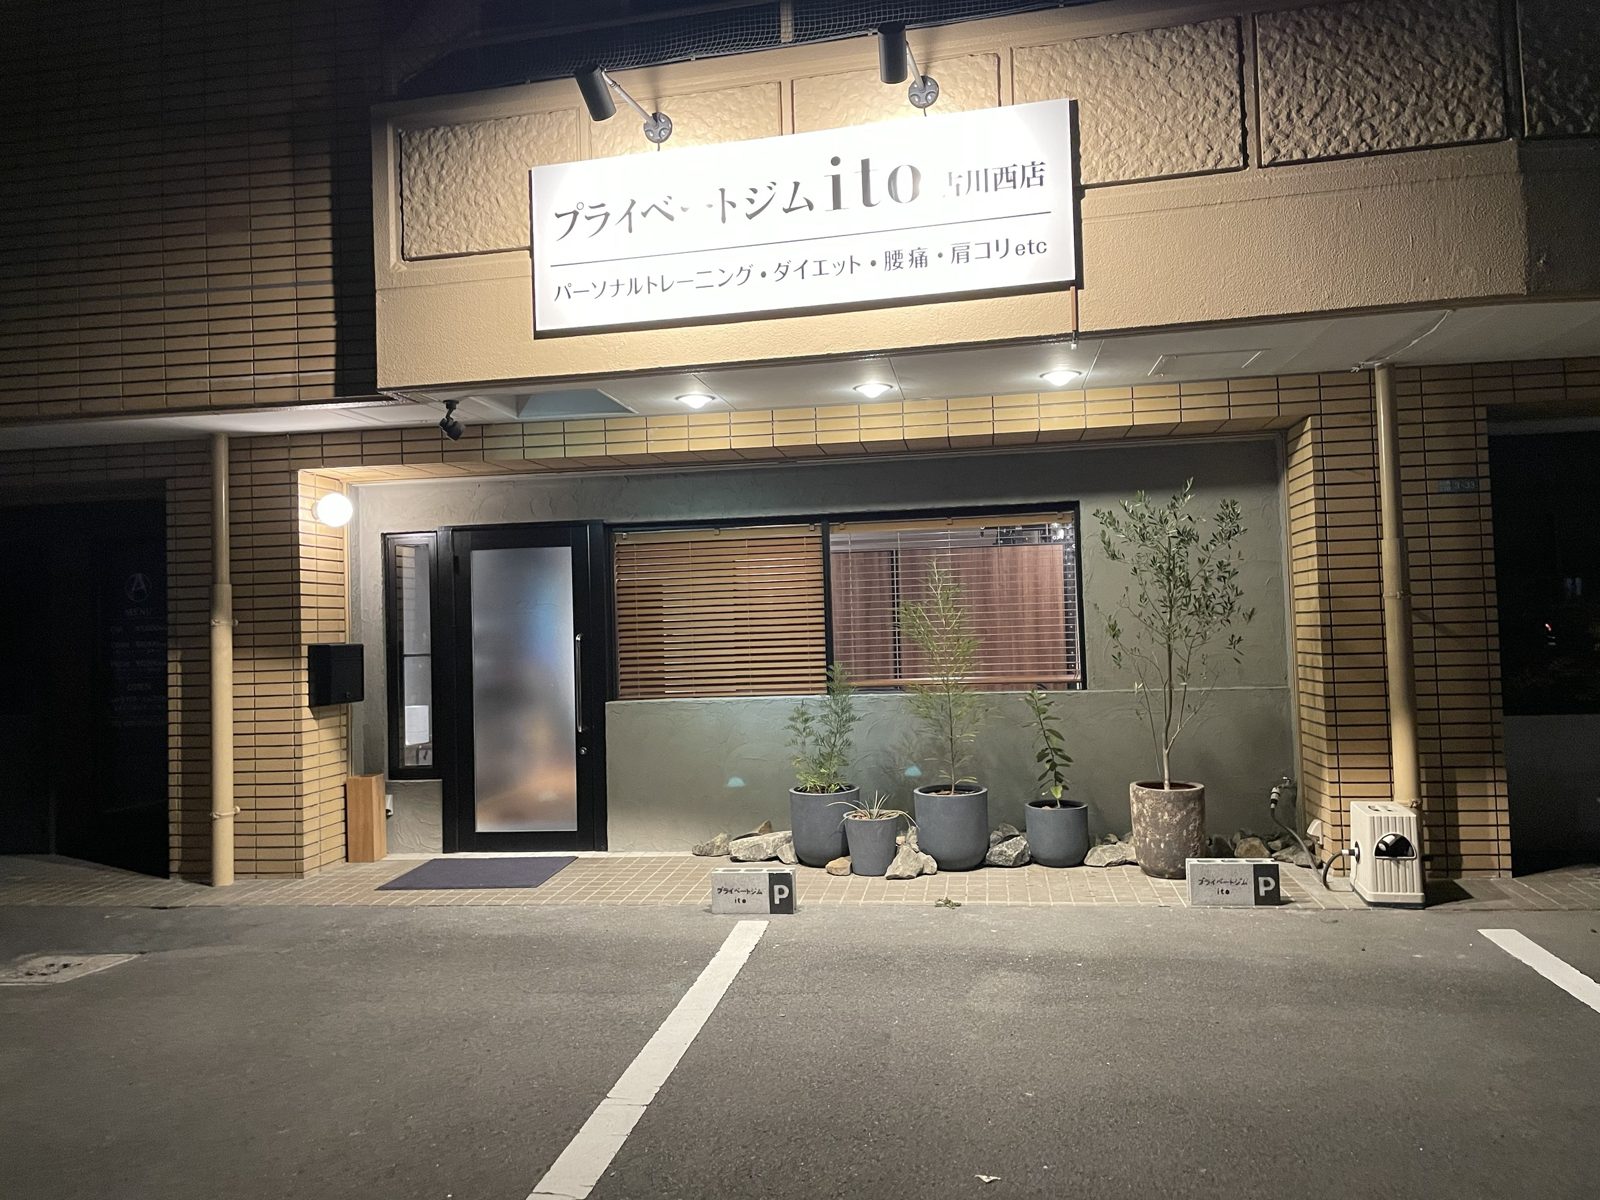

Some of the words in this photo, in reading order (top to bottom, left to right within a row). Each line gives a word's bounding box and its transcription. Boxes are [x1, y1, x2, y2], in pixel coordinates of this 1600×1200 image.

[824, 155, 922, 213] ito
[773, 884, 789, 905] P
[1258, 876, 1276, 896] P
